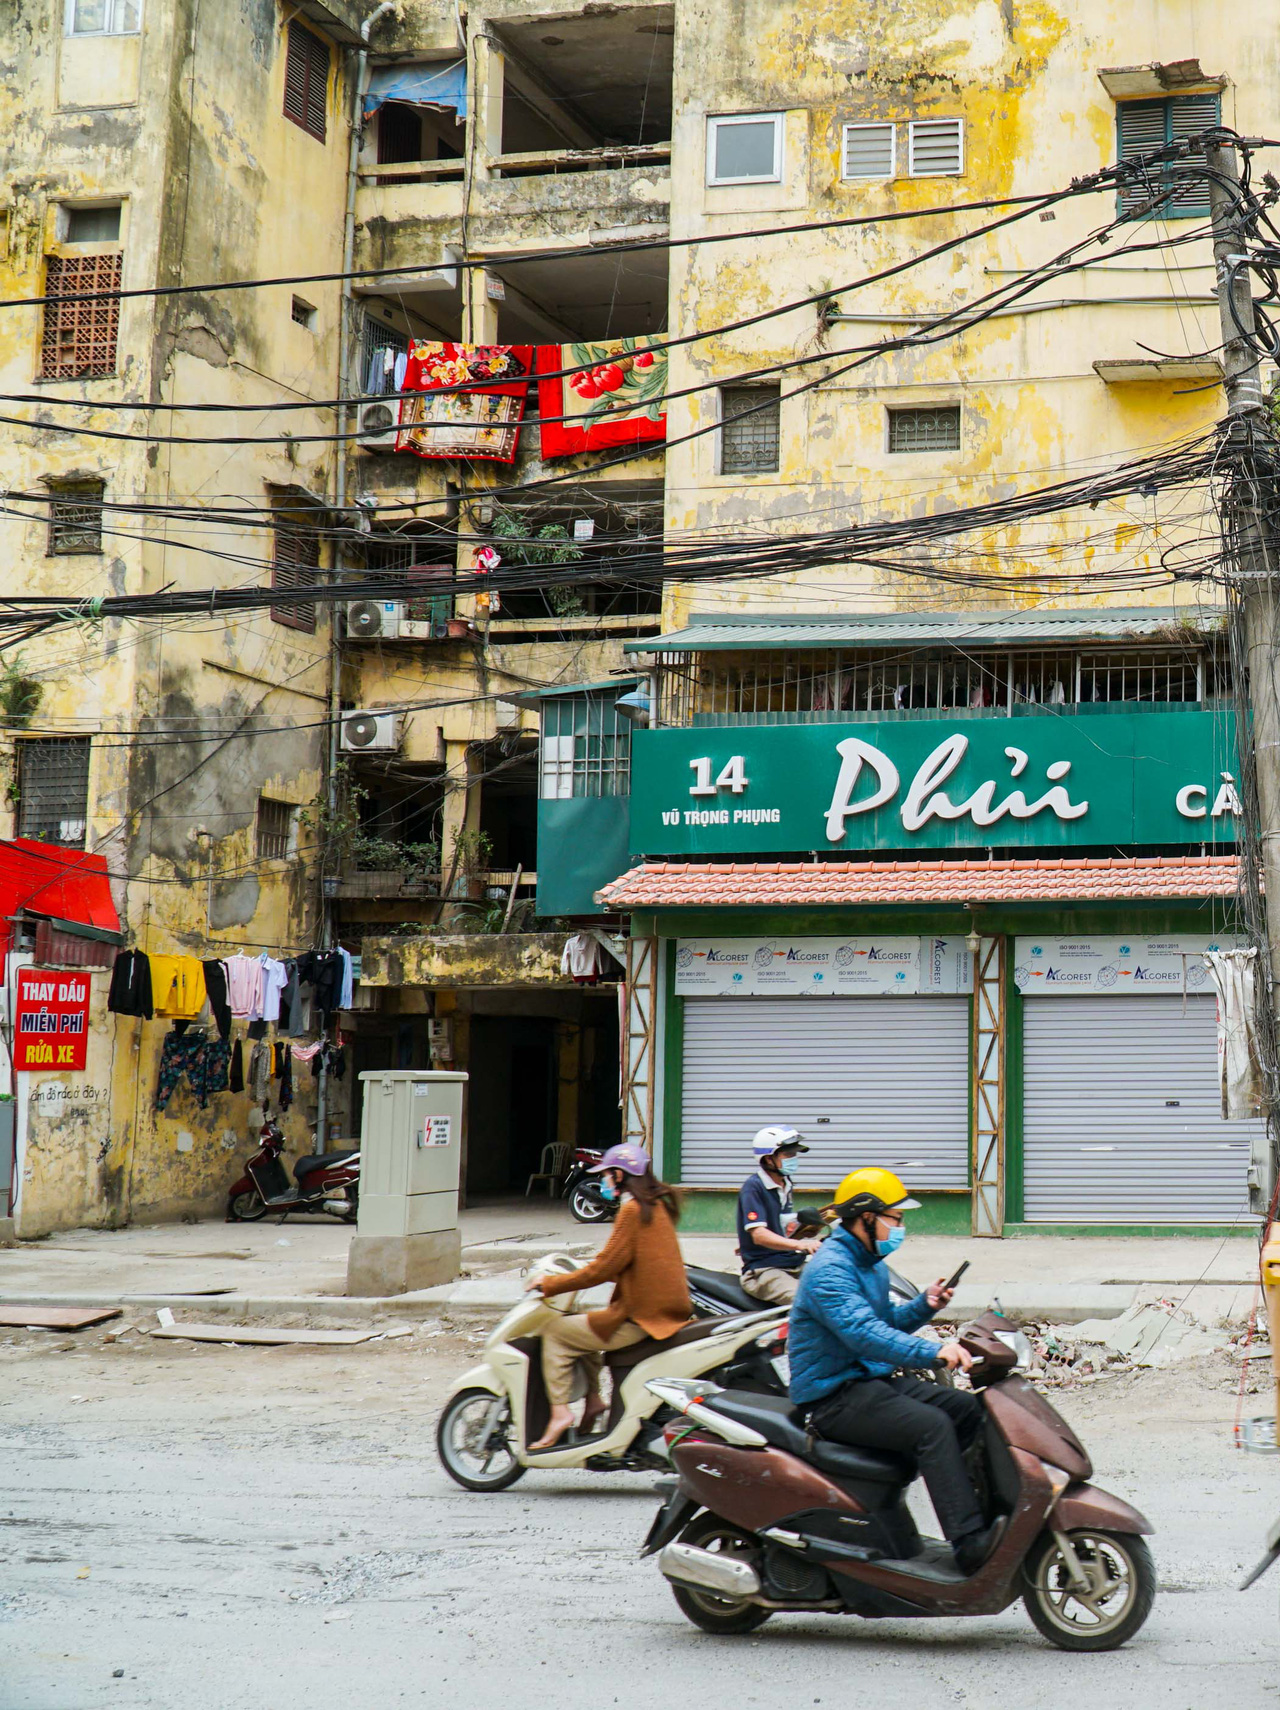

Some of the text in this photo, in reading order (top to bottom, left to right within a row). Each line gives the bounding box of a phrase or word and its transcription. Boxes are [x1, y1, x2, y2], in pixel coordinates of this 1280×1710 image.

[689, 755, 749, 795] 14
[823, 733, 1089, 842] Phủi
[1175, 771, 1244, 818] CÀ
[662, 808, 780, 827] VŨ TRỌNG PHỤNG
[706, 947, 748, 961] ALCOREST
[786, 946, 829, 960] ALCOREST
[868, 946, 912, 960] ALCOREST
[934, 939, 948, 985] ALCOREST
[1046, 966, 1092, 980] ALCOREST
[1134, 966, 1180, 980] ALCOREST
[22, 978, 86, 1002] THAY DẦU
[20, 1006, 86, 1034] MIỄN PHÍ
[25, 1039, 74, 1063] RỬA XE
[82, 1084, 100, 1101] đây
